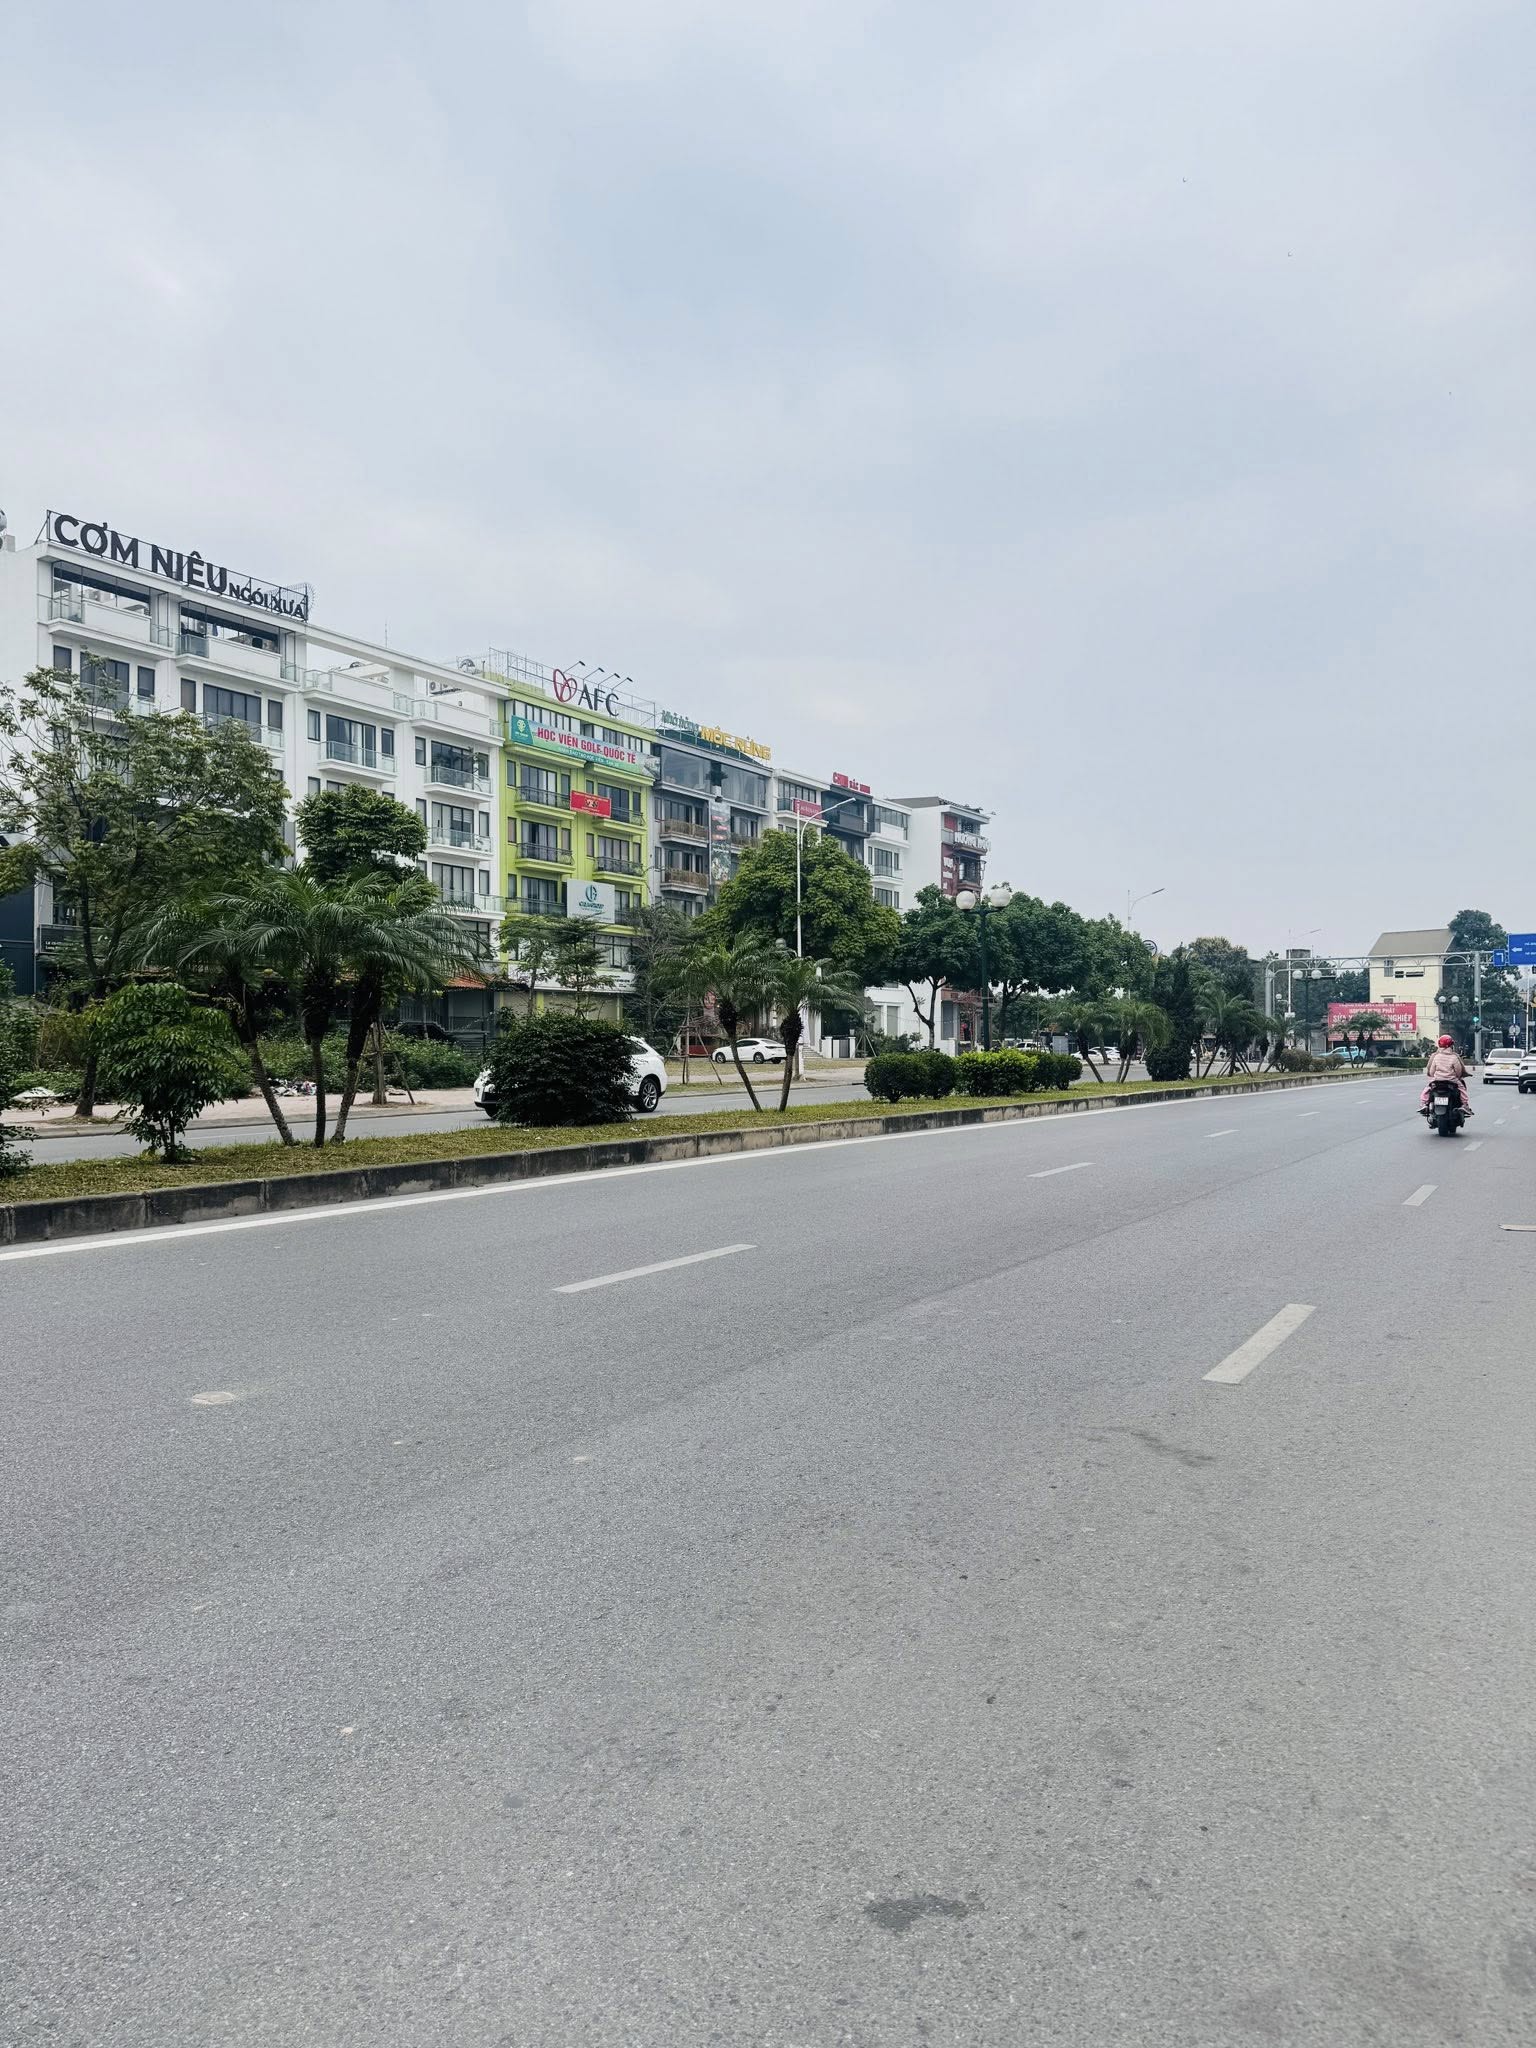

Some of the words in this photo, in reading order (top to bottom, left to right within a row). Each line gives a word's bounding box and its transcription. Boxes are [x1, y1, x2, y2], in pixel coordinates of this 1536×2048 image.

[54, 514, 139, 568] CƠM
[151, 543, 228, 594] NIÊU
[578, 684, 619, 717] AFC
[537, 727, 556, 742] HỌC
[558, 733, 578, 748] VIỆN
[581, 739, 602, 753] GOLF
